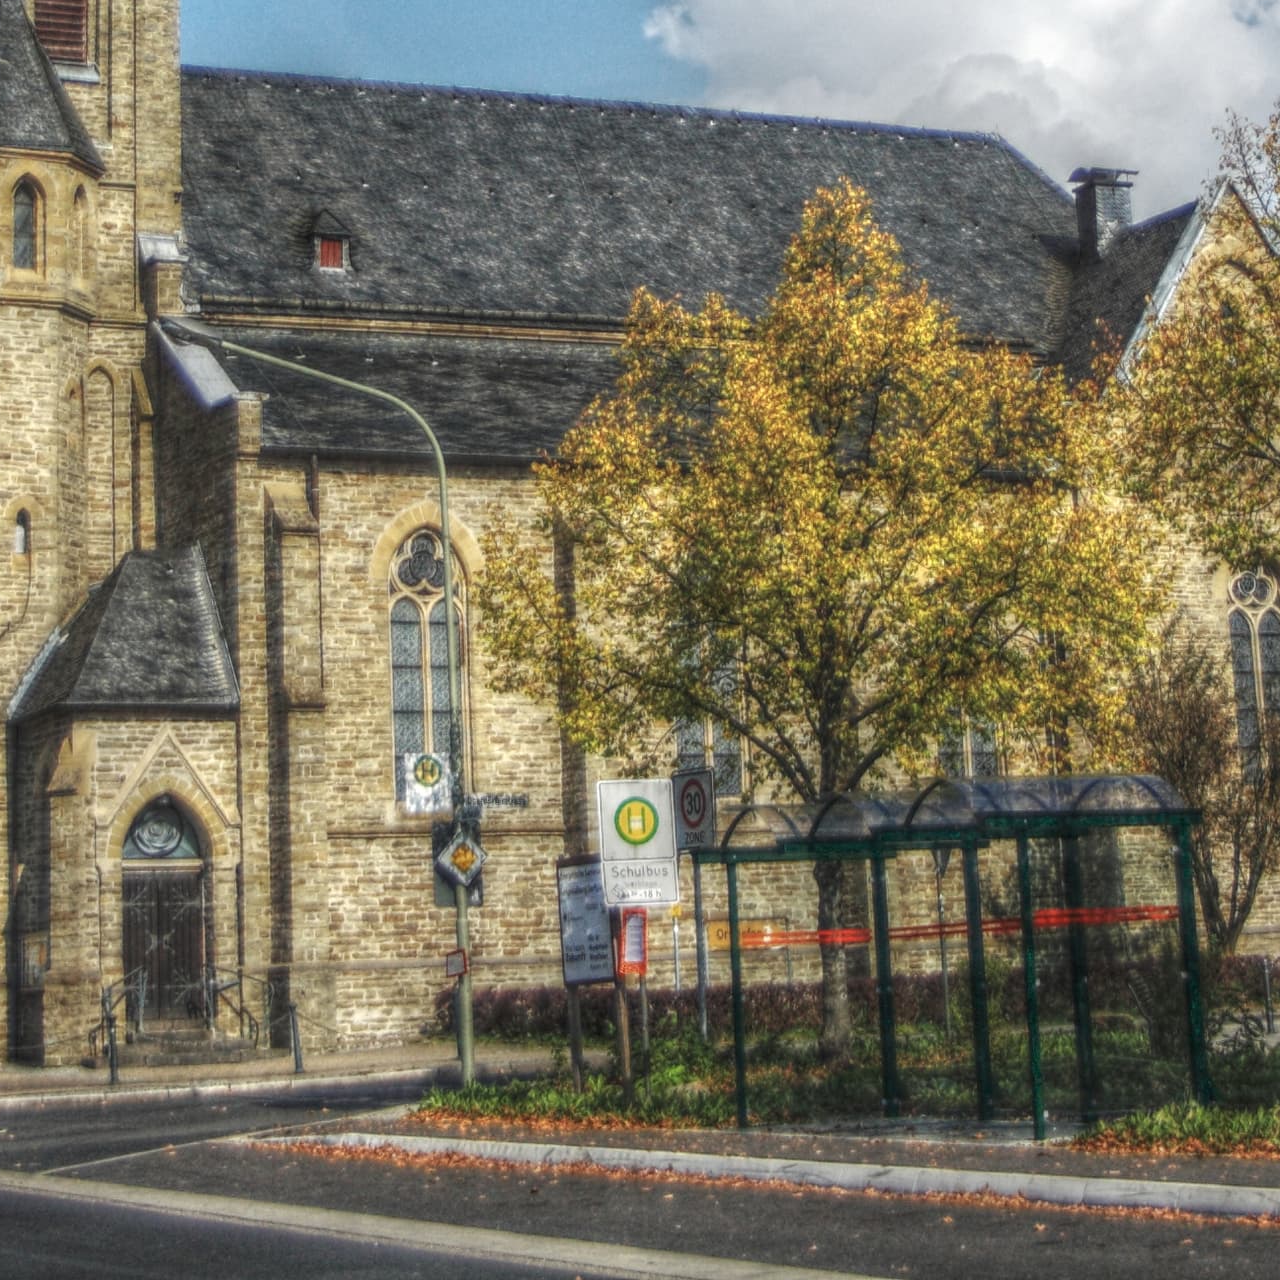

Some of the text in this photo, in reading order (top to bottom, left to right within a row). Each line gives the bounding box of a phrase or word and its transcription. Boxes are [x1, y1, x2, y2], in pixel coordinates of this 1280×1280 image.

[686, 792, 701, 815] 30
[627, 806, 646, 835] H
[685, 830, 705, 845] ZONE
[611, 865, 669, 879] Schulbus
